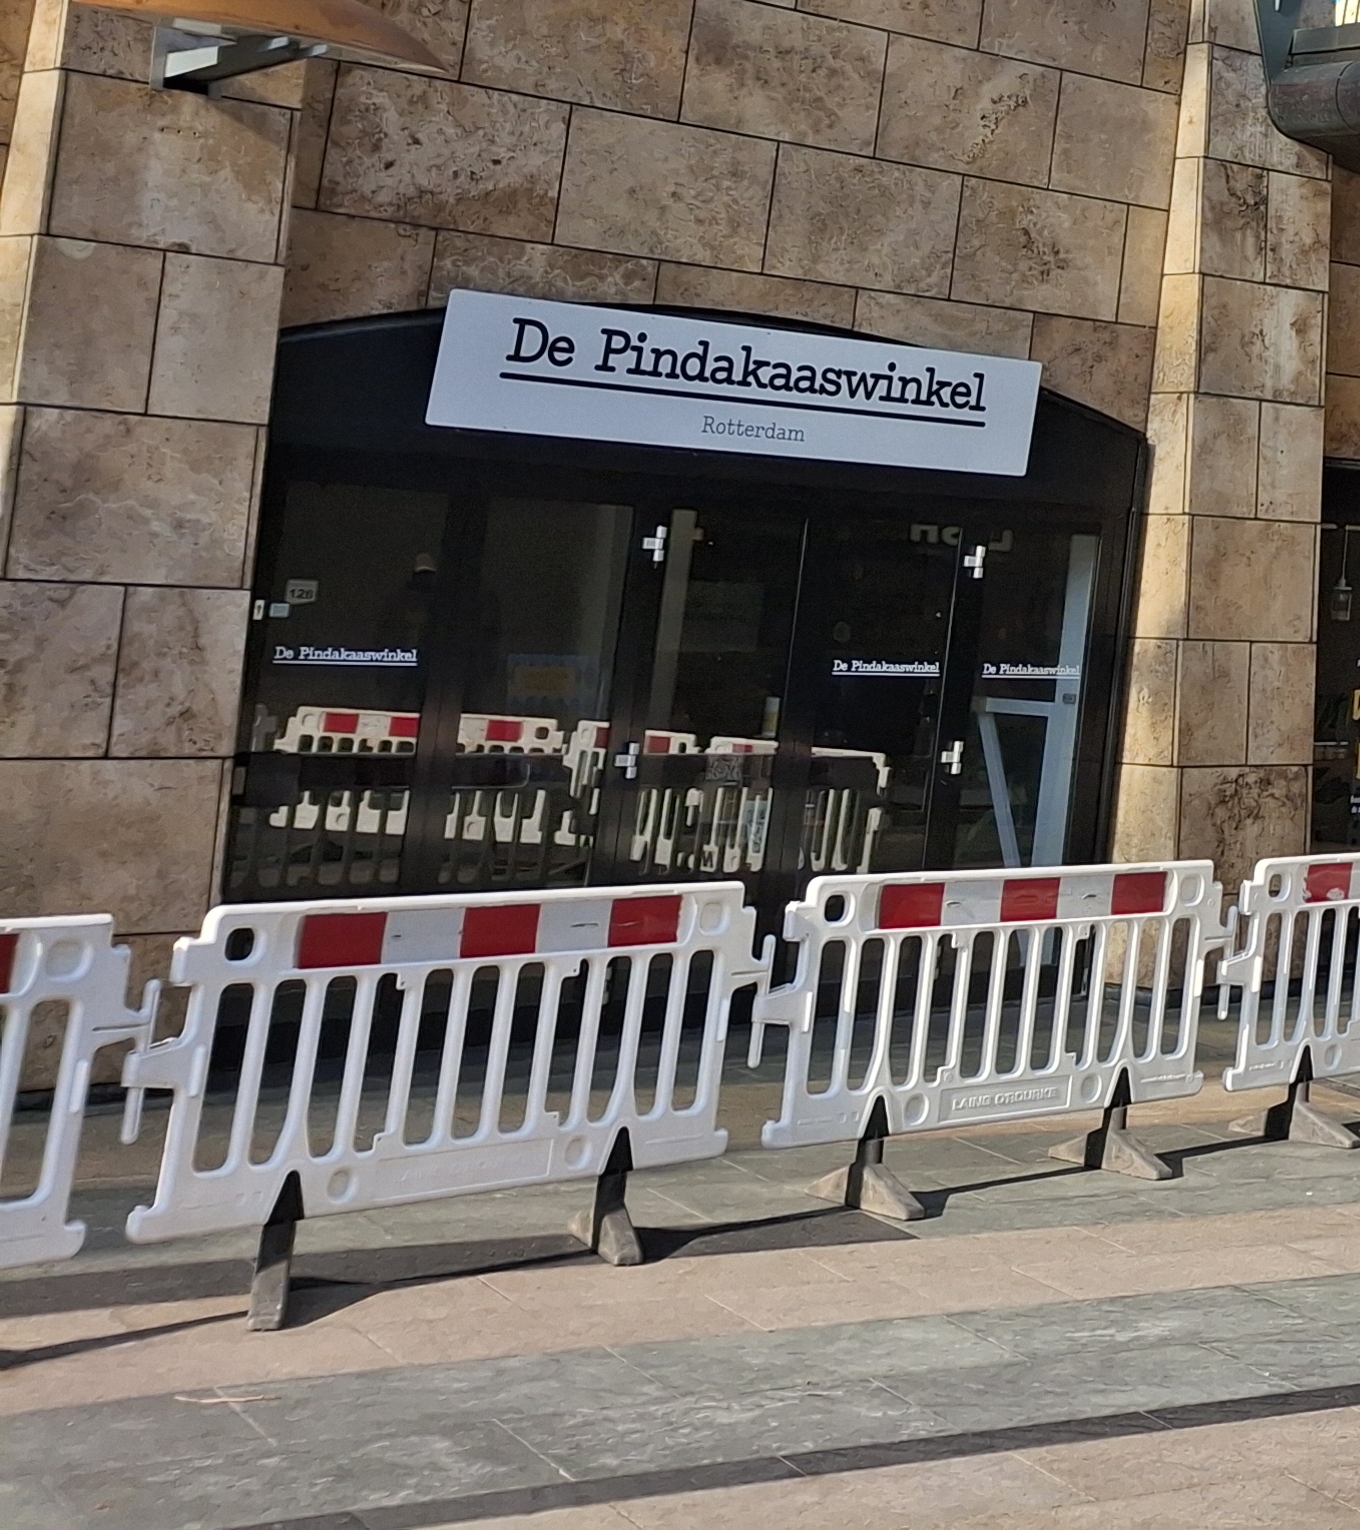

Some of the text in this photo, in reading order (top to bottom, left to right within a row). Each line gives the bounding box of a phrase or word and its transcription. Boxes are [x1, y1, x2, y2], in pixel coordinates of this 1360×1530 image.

[506, 317, 987, 412] De Pindakaaswinkel
[701, 414, 806, 443] Rotterdam
[274, 646, 418, 662] De Pindakaaswinkel
[833, 660, 940, 673] De Pindakaaswinkel
[983, 663, 996, 675] De
